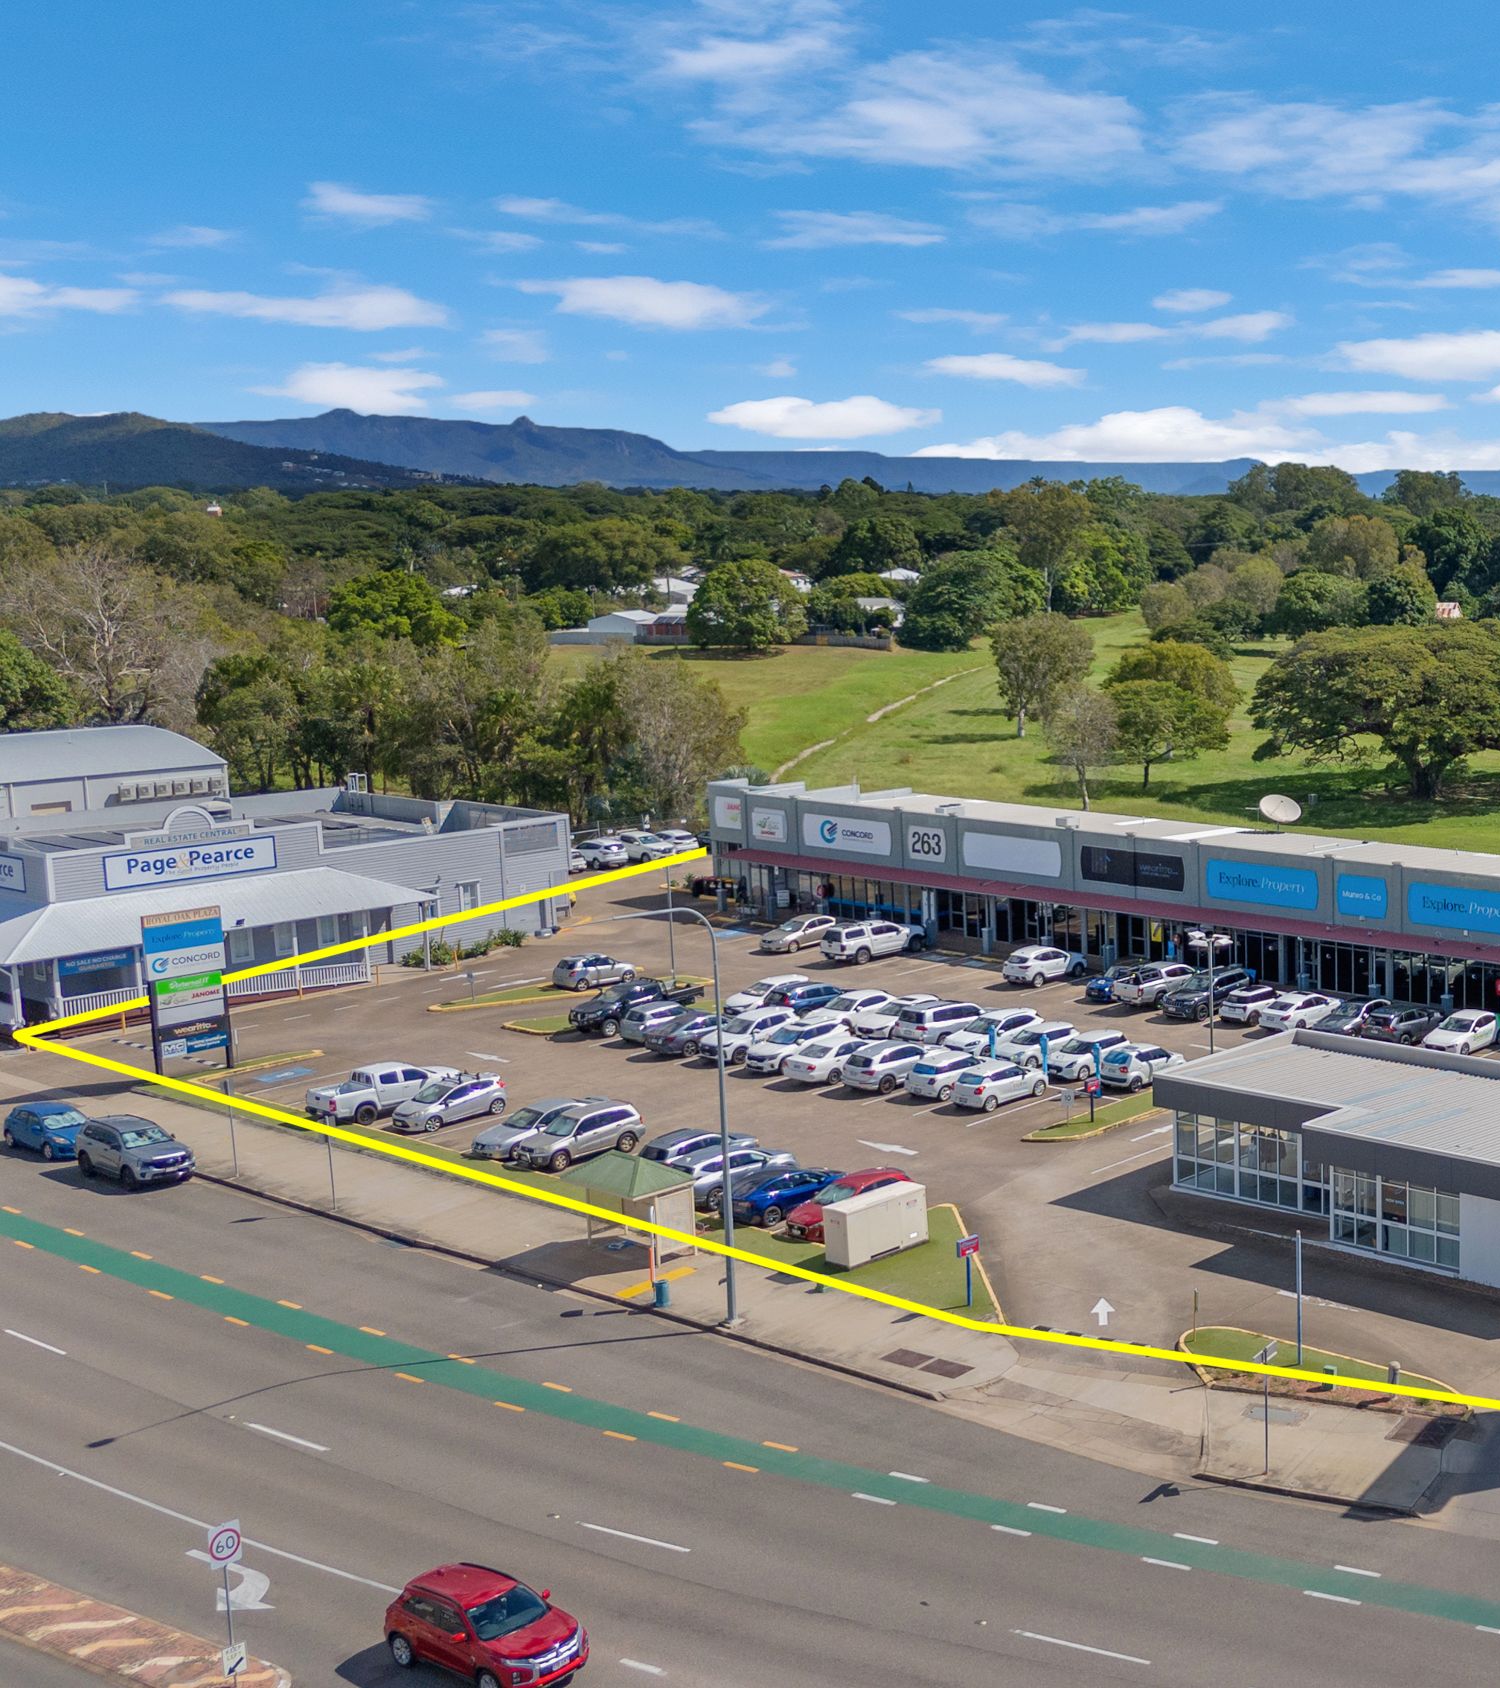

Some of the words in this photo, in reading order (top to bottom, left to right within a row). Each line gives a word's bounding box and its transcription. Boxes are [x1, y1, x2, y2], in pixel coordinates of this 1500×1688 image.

[144, 837, 166, 846] REAL
[168, 833, 198, 843] ESTATE
[200, 828, 238, 839] CENTRAL
[841, 829, 874, 840] CONCORD
[912, 831, 942, 856] 263
[127, 856, 177, 875] Page
[188, 847, 255, 867] Pearce
[146, 914, 170, 926] ROYAL
[174, 912, 192, 922] OAK
[192, 907, 219, 919] PLAZA
[171, 951, 220, 966] CONCORD
[191, 988, 220, 999] JANOME
[215, 1535, 235, 1554] 60
